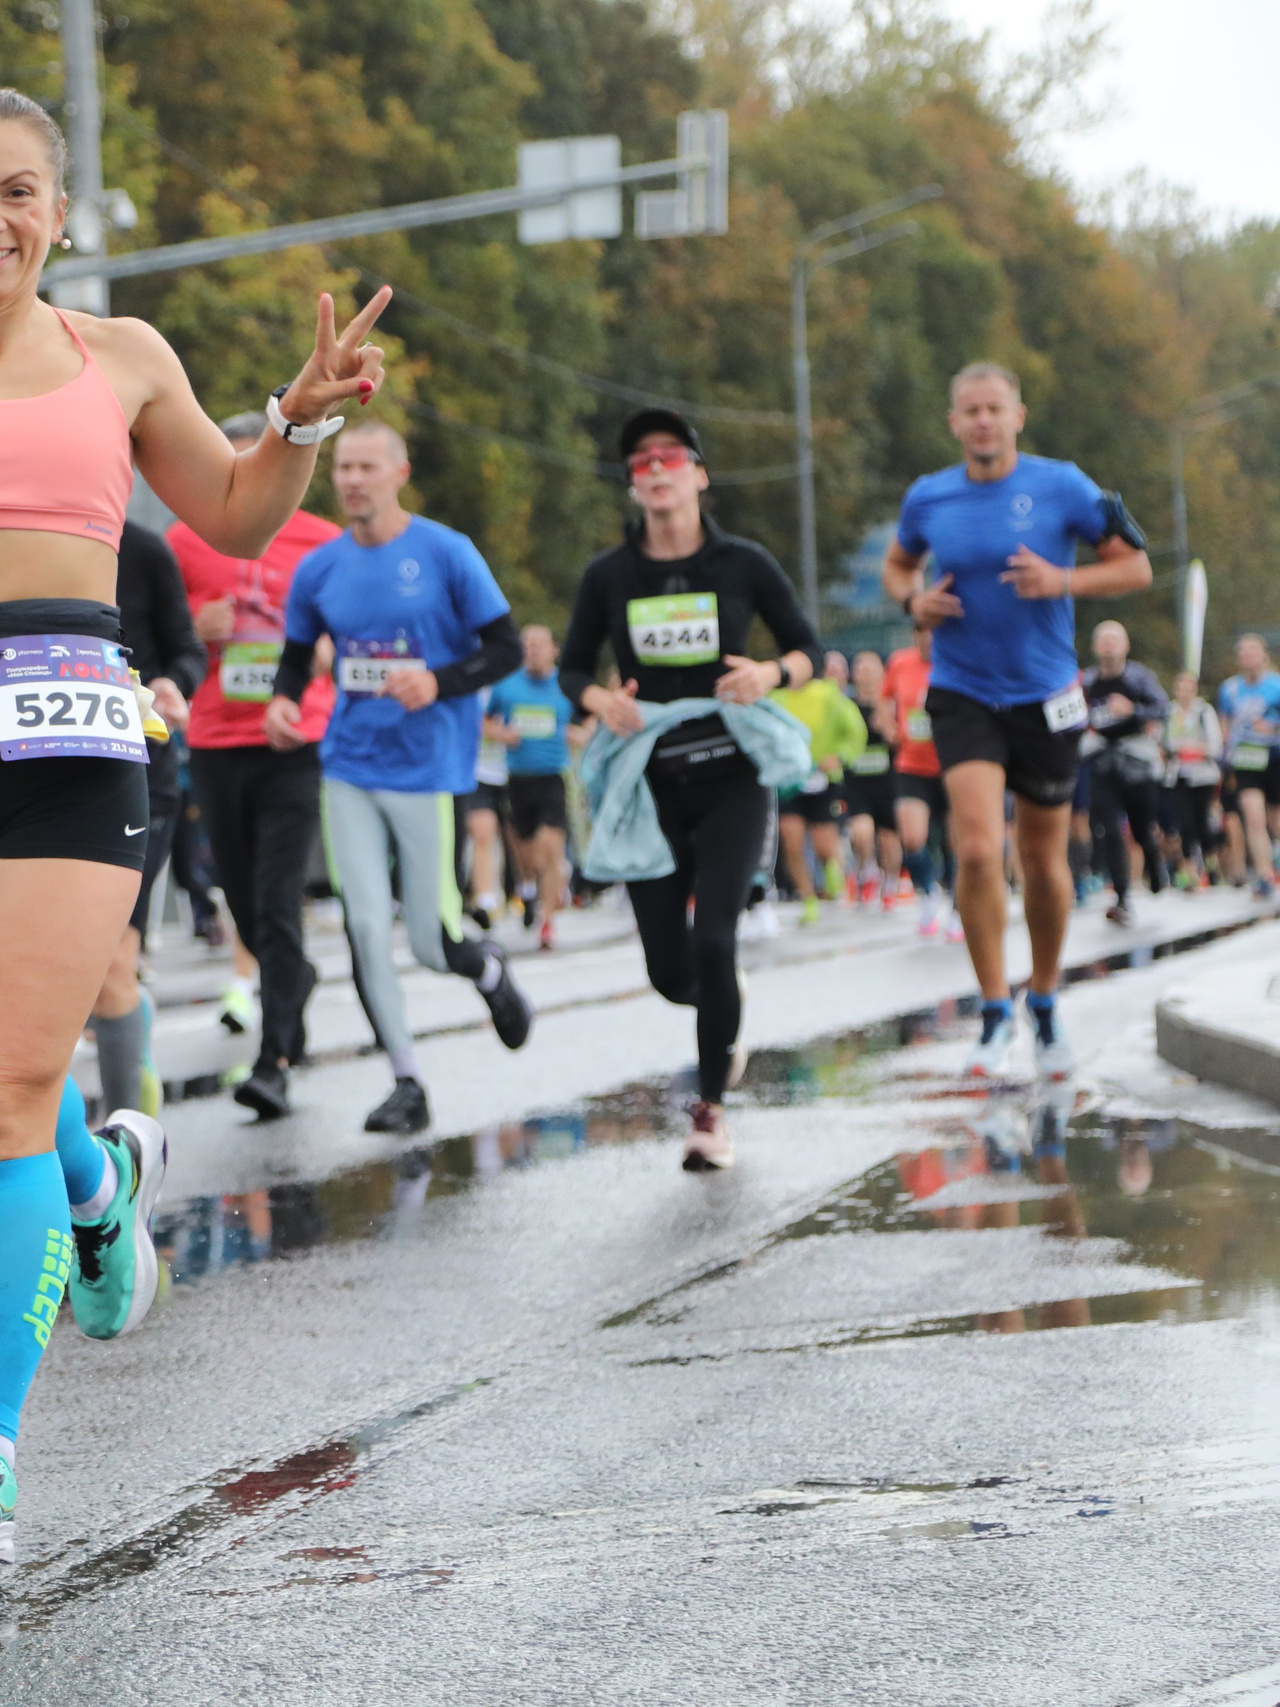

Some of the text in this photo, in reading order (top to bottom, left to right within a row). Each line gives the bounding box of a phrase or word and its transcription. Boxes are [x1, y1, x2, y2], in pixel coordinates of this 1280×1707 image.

[643, 627, 710, 648] 4244
[6, 664, 49, 674] Полумарафон
[15, 691, 130, 730] 5276
[110, 742, 128, 753] 21.1
